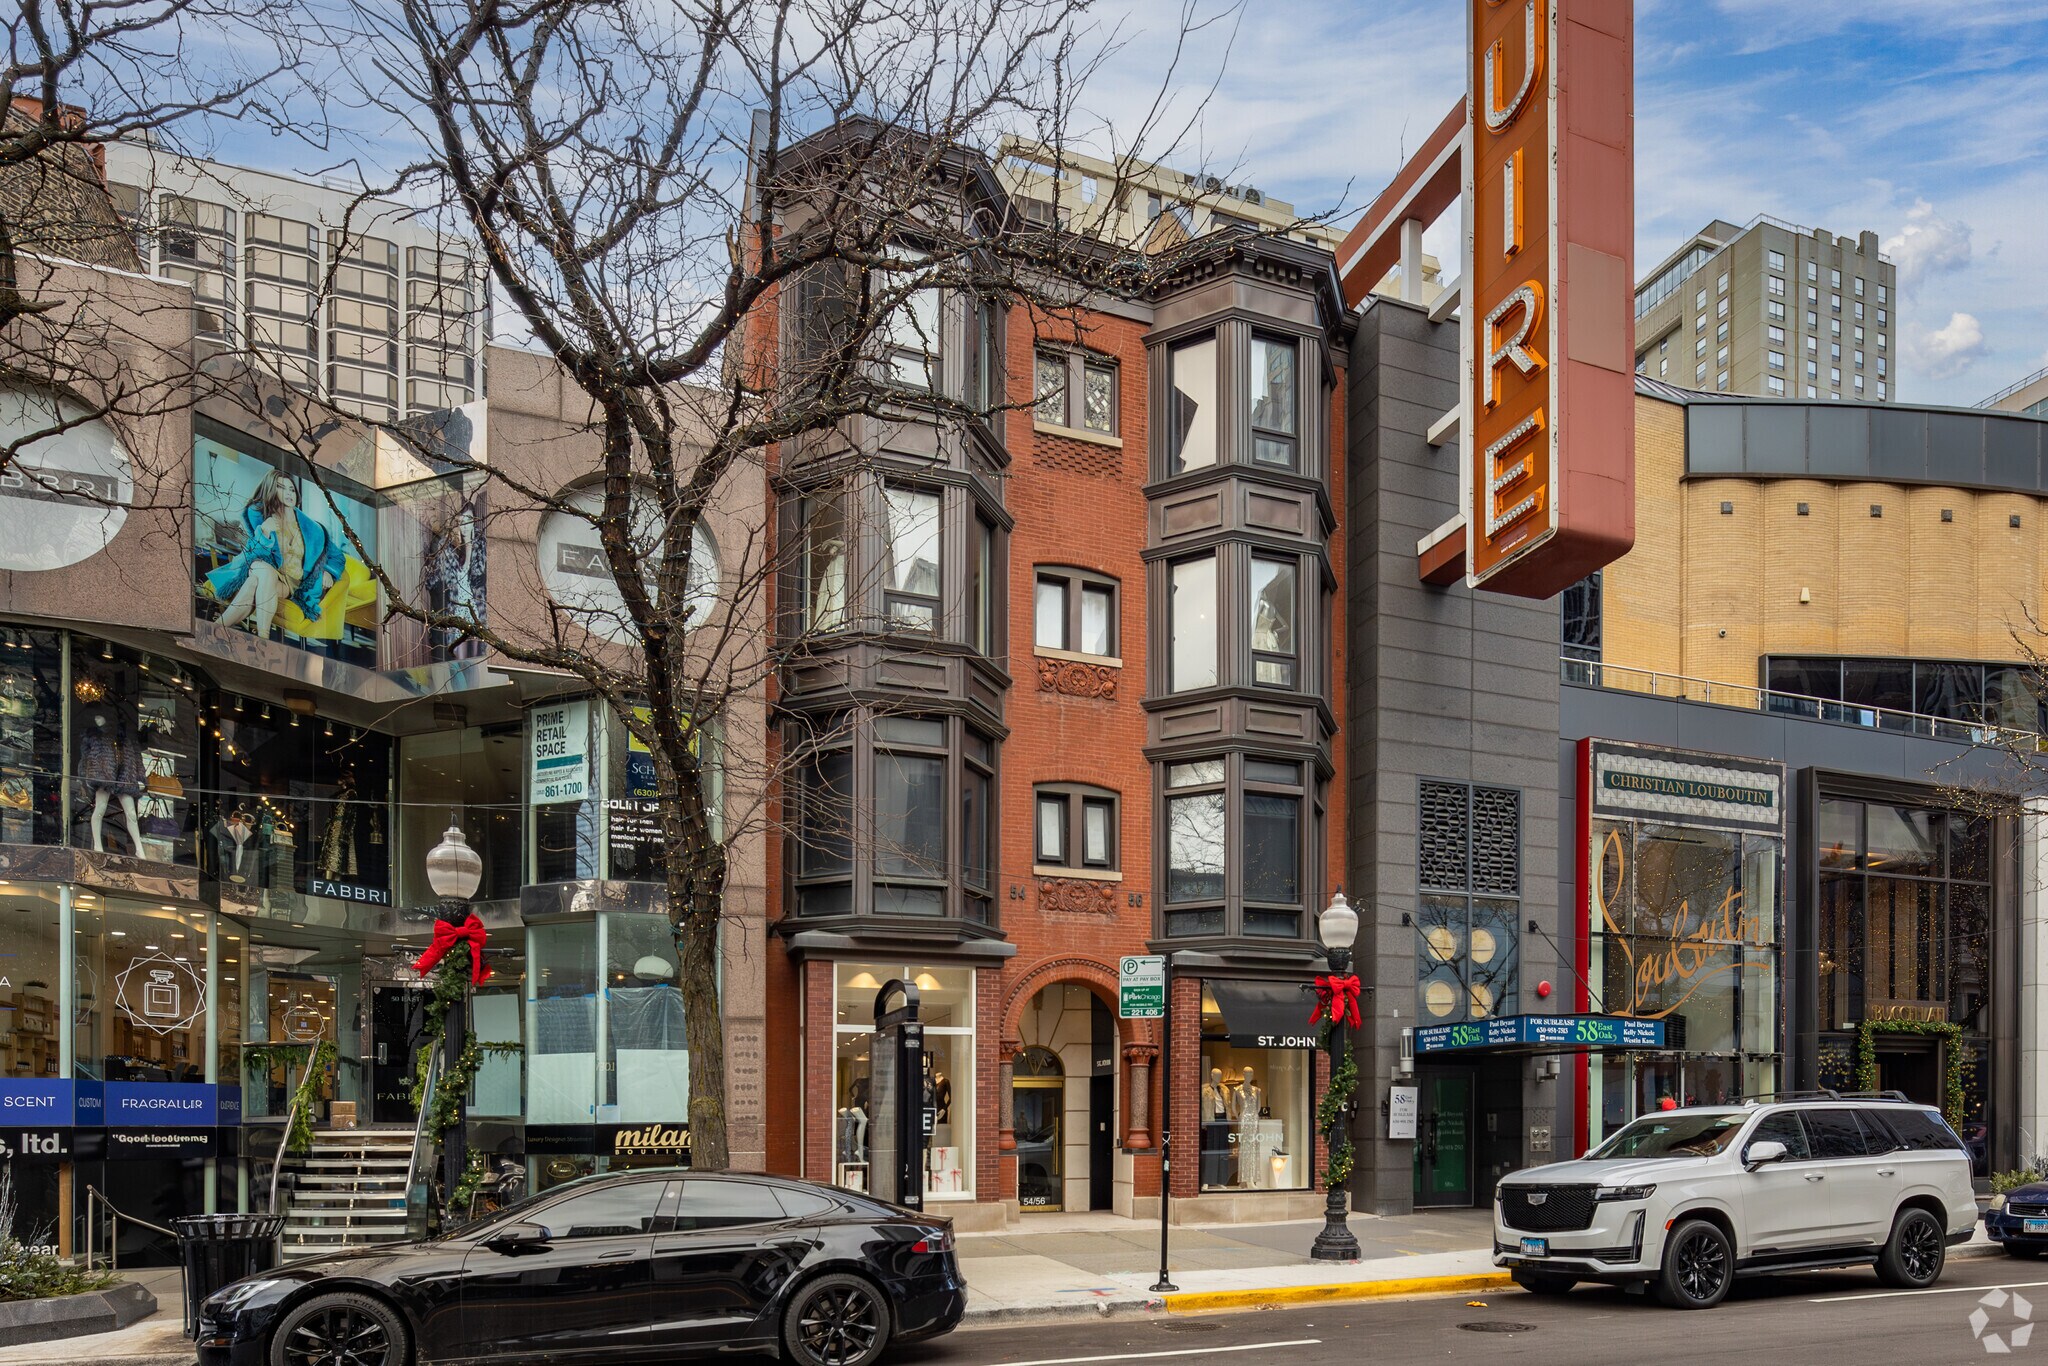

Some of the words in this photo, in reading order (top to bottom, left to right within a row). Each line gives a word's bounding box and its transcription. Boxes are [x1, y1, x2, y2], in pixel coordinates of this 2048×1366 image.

[1484, 0, 1548, 545] UIRE
[536, 711, 564, 727] PRIME
[536, 726, 567, 742] RETAIL
[536, 741, 566, 757] SPACE
[545, 781, 582, 797] 861-1700
[1610, 773, 1685, 794] CHRISTIAN
[1689, 783, 1767, 804] LOUBOUTIN
[313, 880, 387, 904] FABBRI
[1010, 884, 1025, 900] 54
[1128, 893, 1143, 908] 56
[1543, 1018, 1575, 1026] SUBLEASE
[1598, 1023, 1613, 1031] East
[1637, 1021, 1654, 1029] Bryant
[1451, 1025, 1468, 1046] 58
[1468, 1026, 1480, 1034] East
[1576, 1020, 1598, 1041] 58
[1599, 1031, 1613, 1039] Oak
[1257, 1035, 1277, 1046] ST.
[1279, 1036, 1316, 1047] JOHN
[1468, 1034, 1480, 1042] Oak
[4, 1096, 56, 1107] SCENT
[1394, 1094, 1405, 1104] 58
[615, 1124, 691, 1147] milan
[1249, 1133, 1284, 1143] JOHN
[22, 1133, 68, 1154] ltd.
[1023, 1197, 1046, 1206] 54/56
